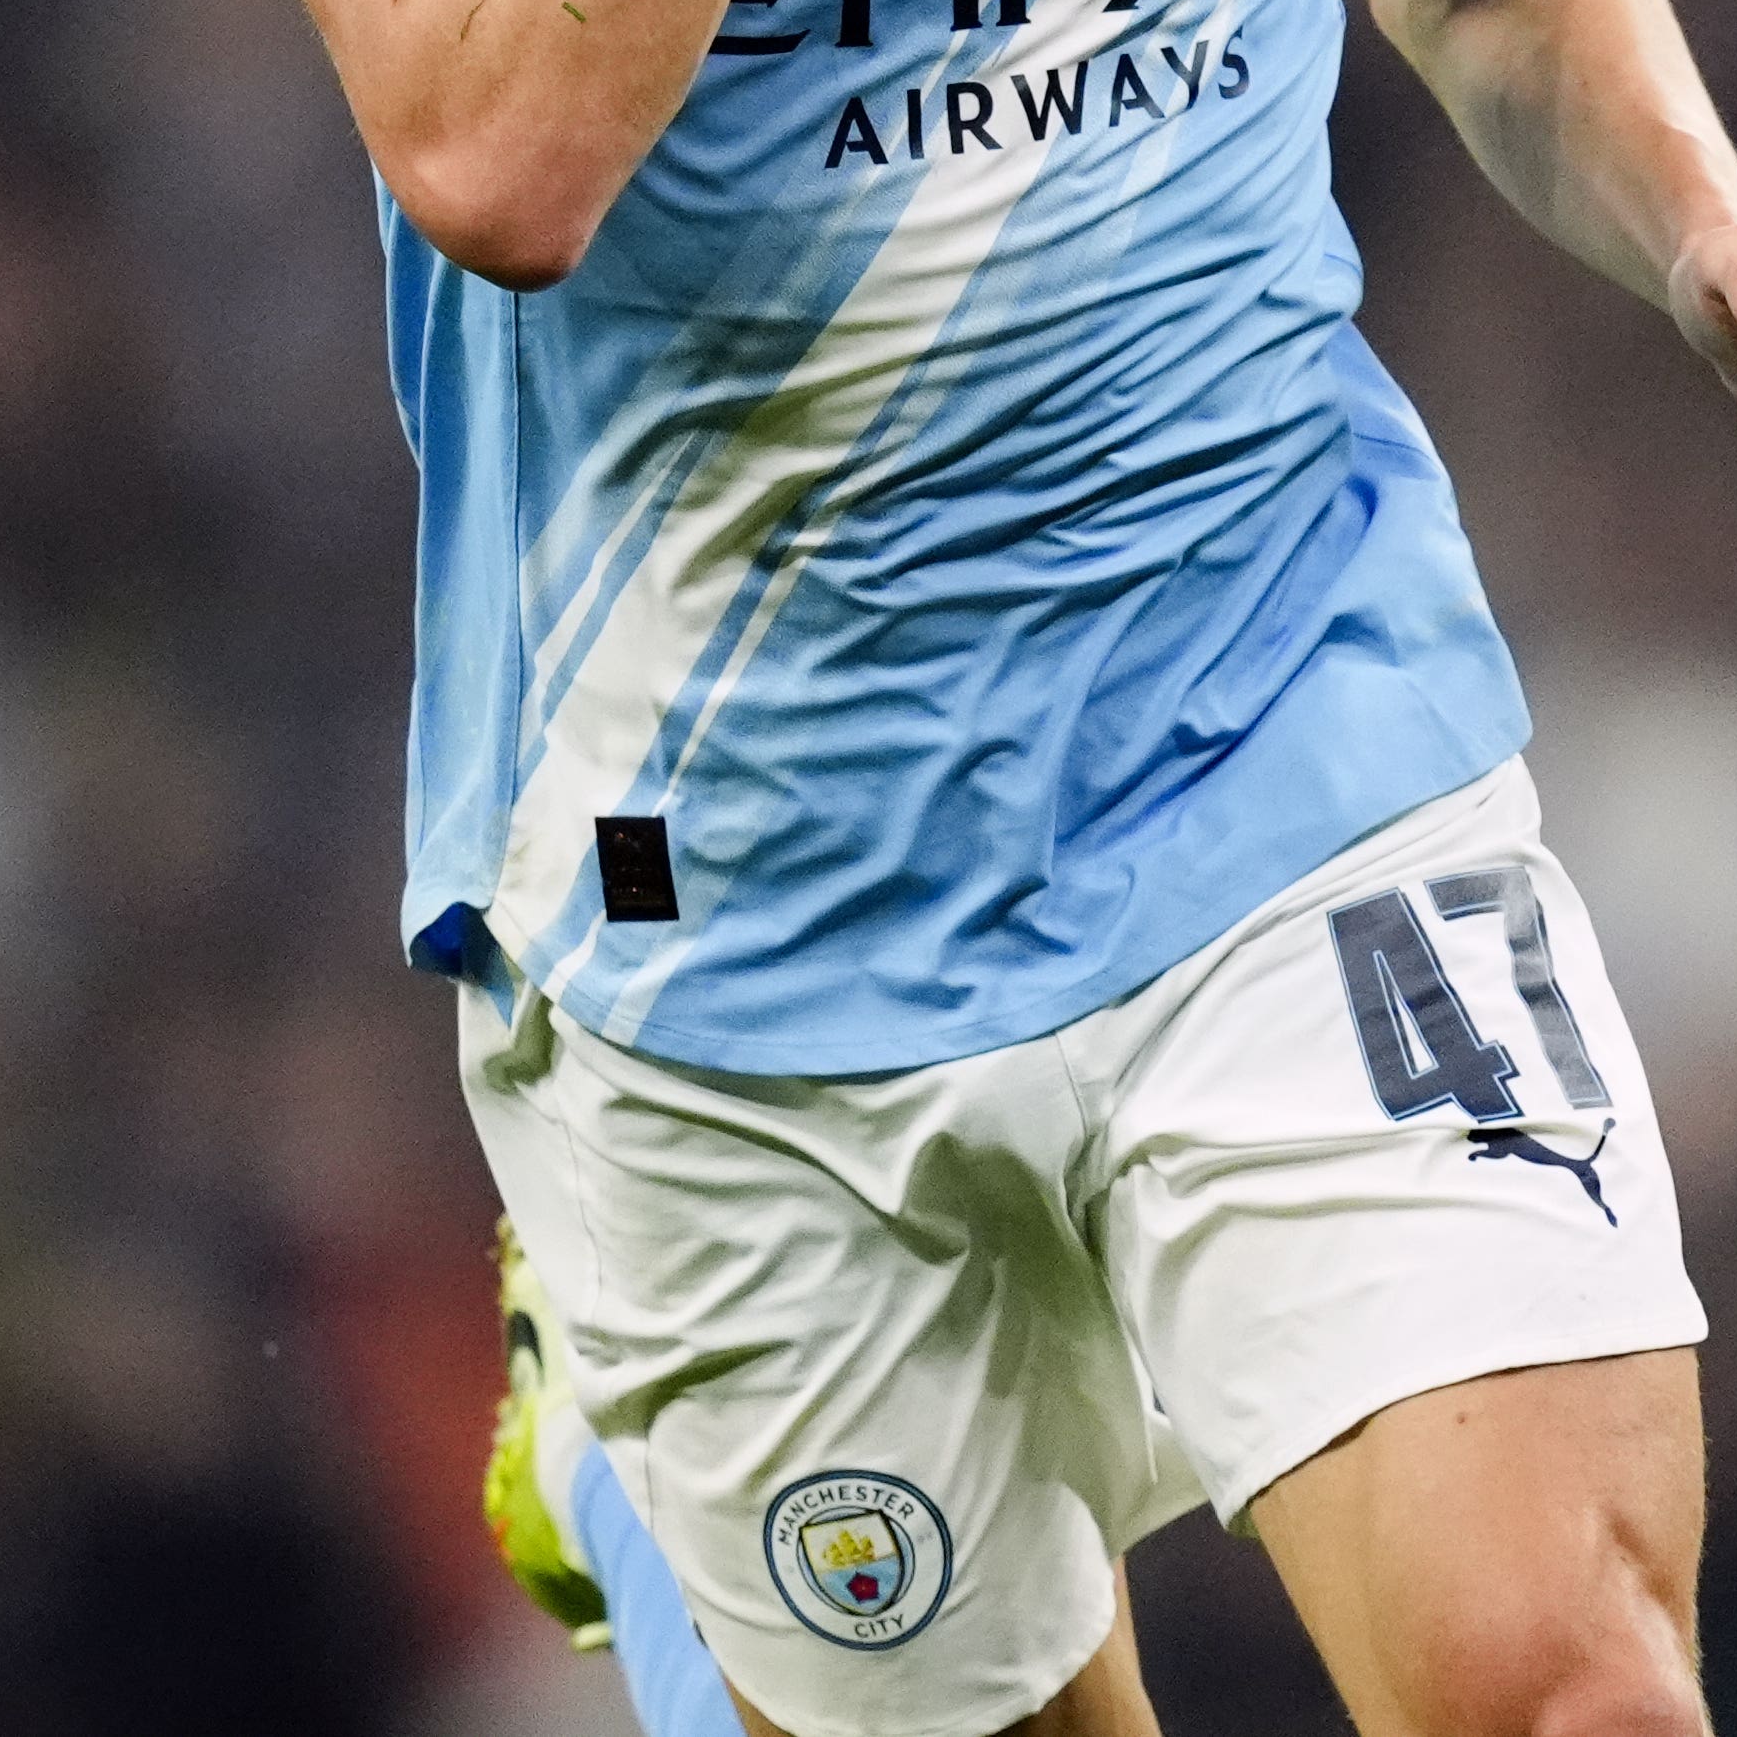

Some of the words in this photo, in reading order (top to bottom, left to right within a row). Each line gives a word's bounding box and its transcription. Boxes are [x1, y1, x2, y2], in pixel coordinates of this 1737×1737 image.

[824, 25, 1250, 169] AIRWAYS
[1326, 866, 1614, 1124] 47
[779, 1485, 915, 1546] MANCHESTER
[854, 1614, 904, 1639] CITY
